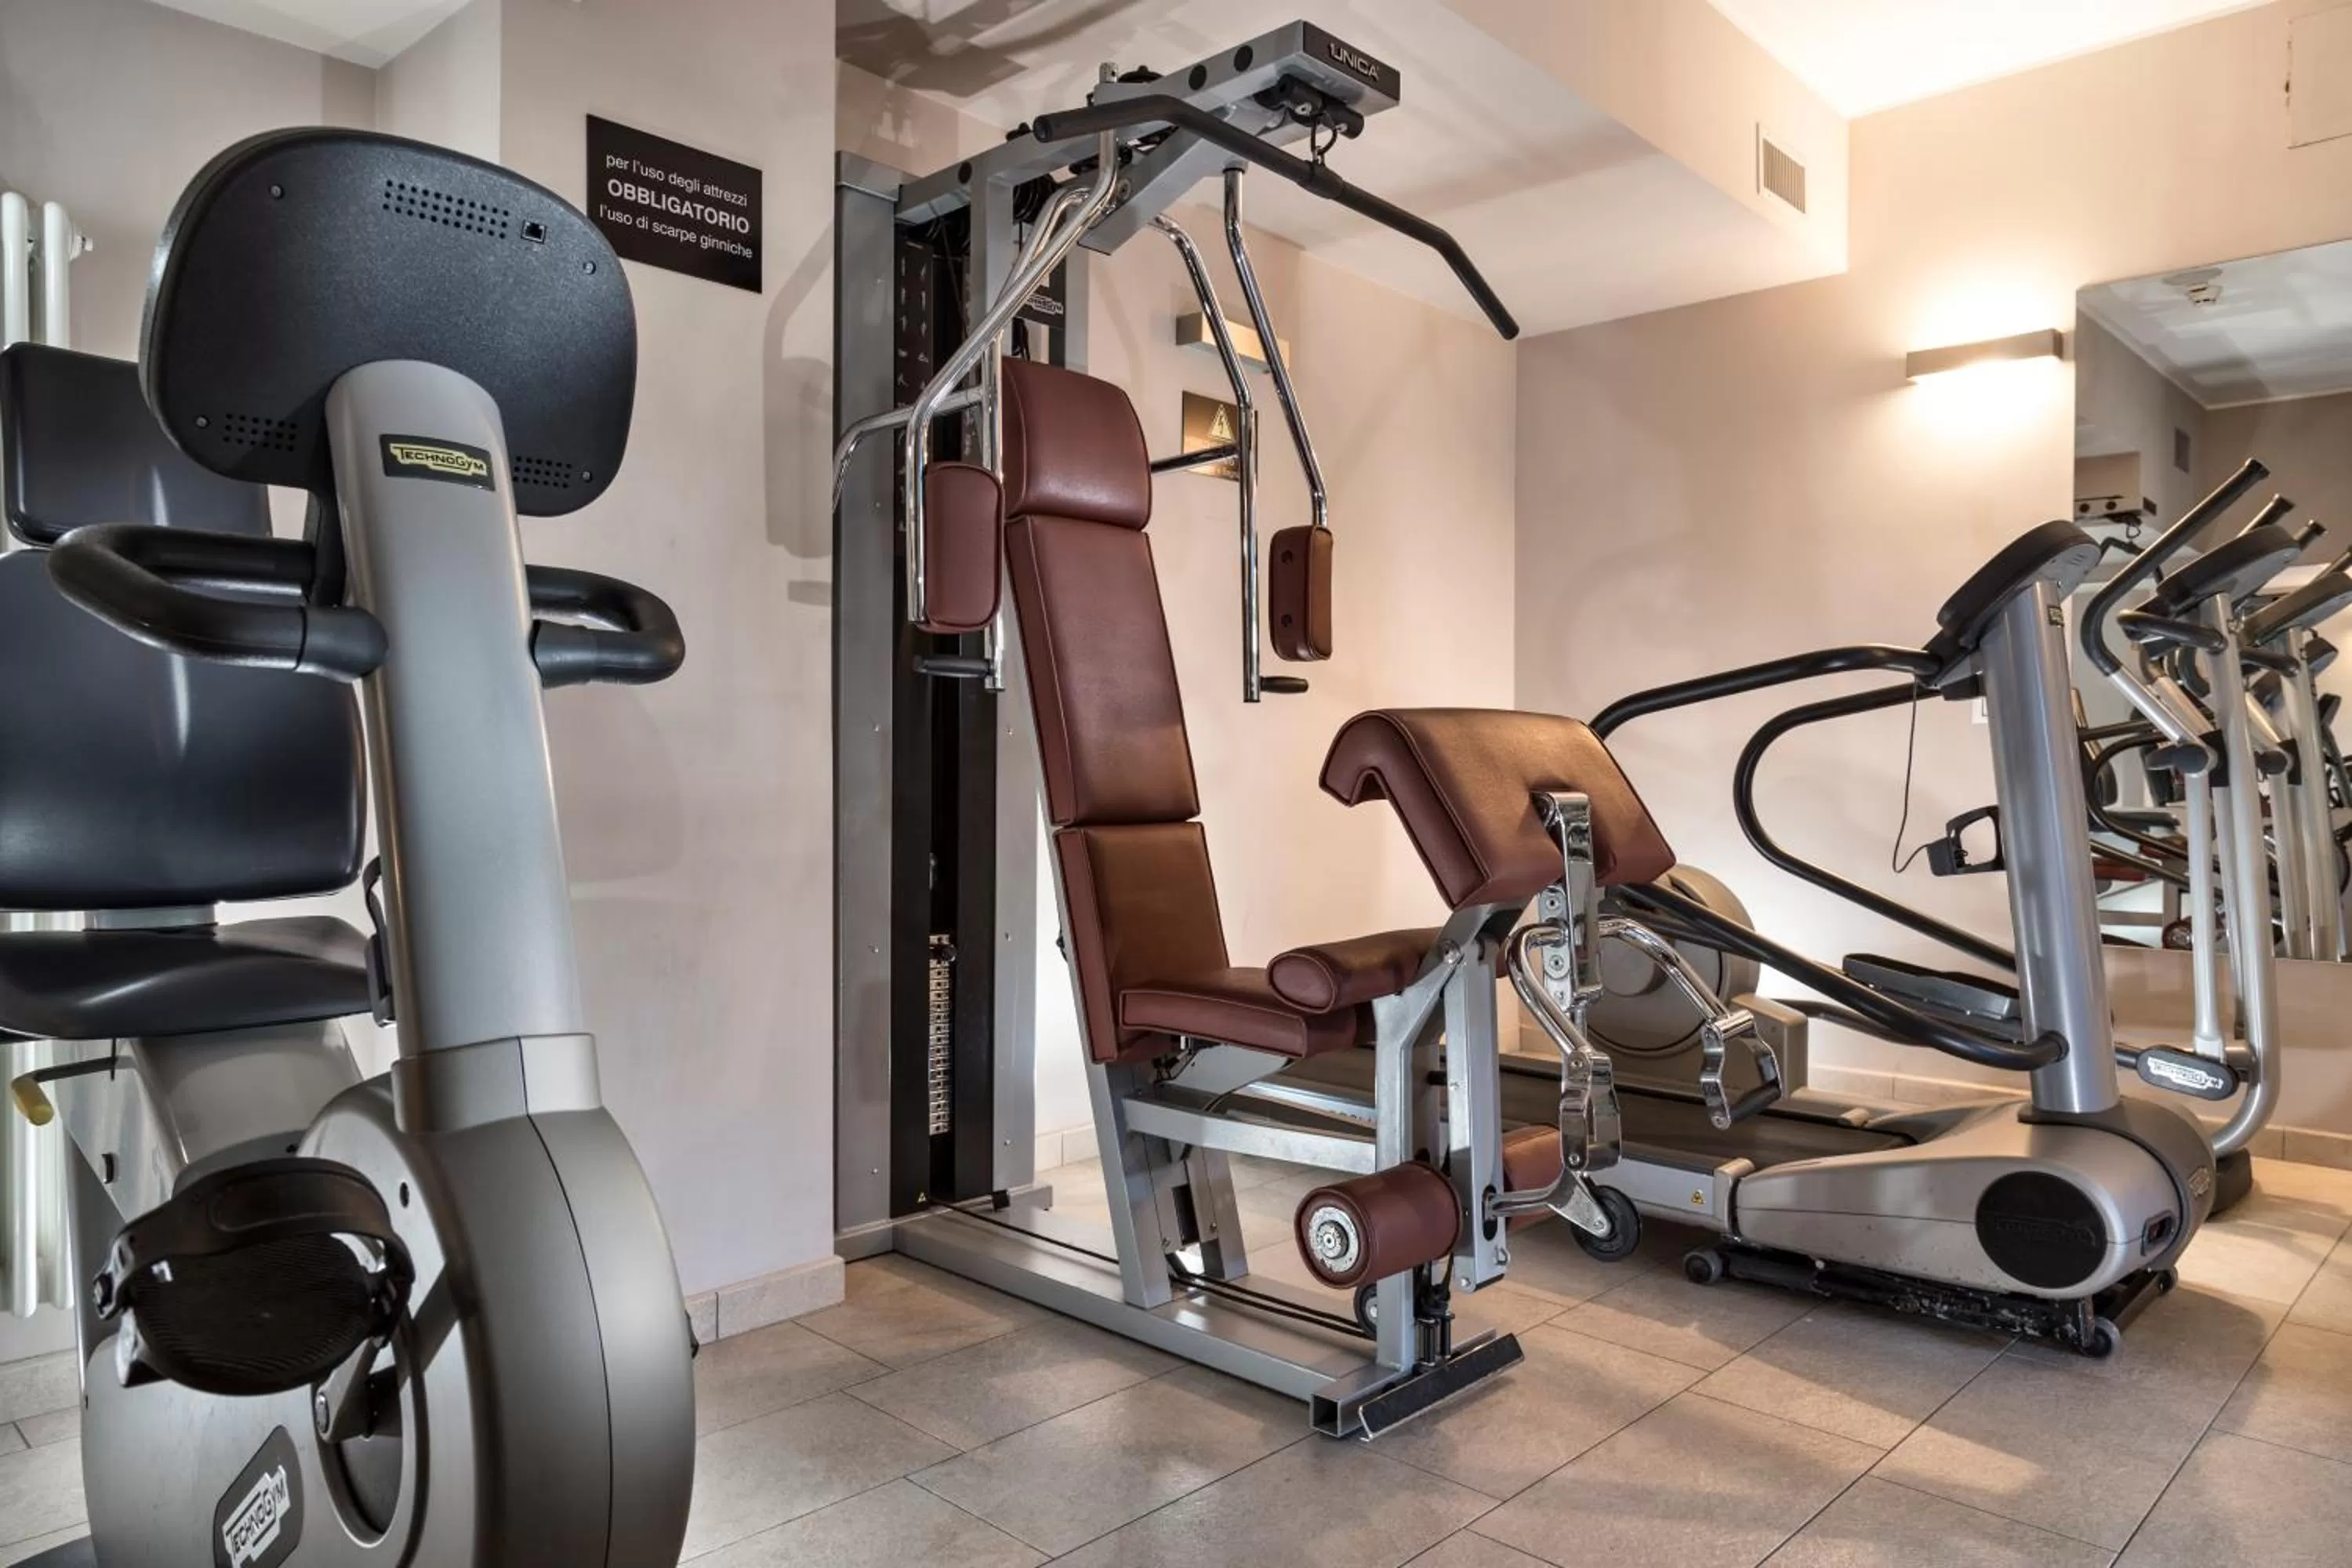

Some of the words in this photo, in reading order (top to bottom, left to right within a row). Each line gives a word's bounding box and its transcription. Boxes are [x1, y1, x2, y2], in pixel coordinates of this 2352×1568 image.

[1329, 42, 1379, 80] UNICA
[605, 154, 629, 169] per
[633, 159, 664, 181] l'uso
[668, 172, 700, 194] degli
[703, 183, 747, 207] attrezzi
[608, 178, 750, 234] OBBLIGATORIO
[599, 204, 632, 226] l'uso
[636, 216, 648, 230] di
[652, 220, 697, 243] scarpe
[700, 234, 753, 259] ginniche
